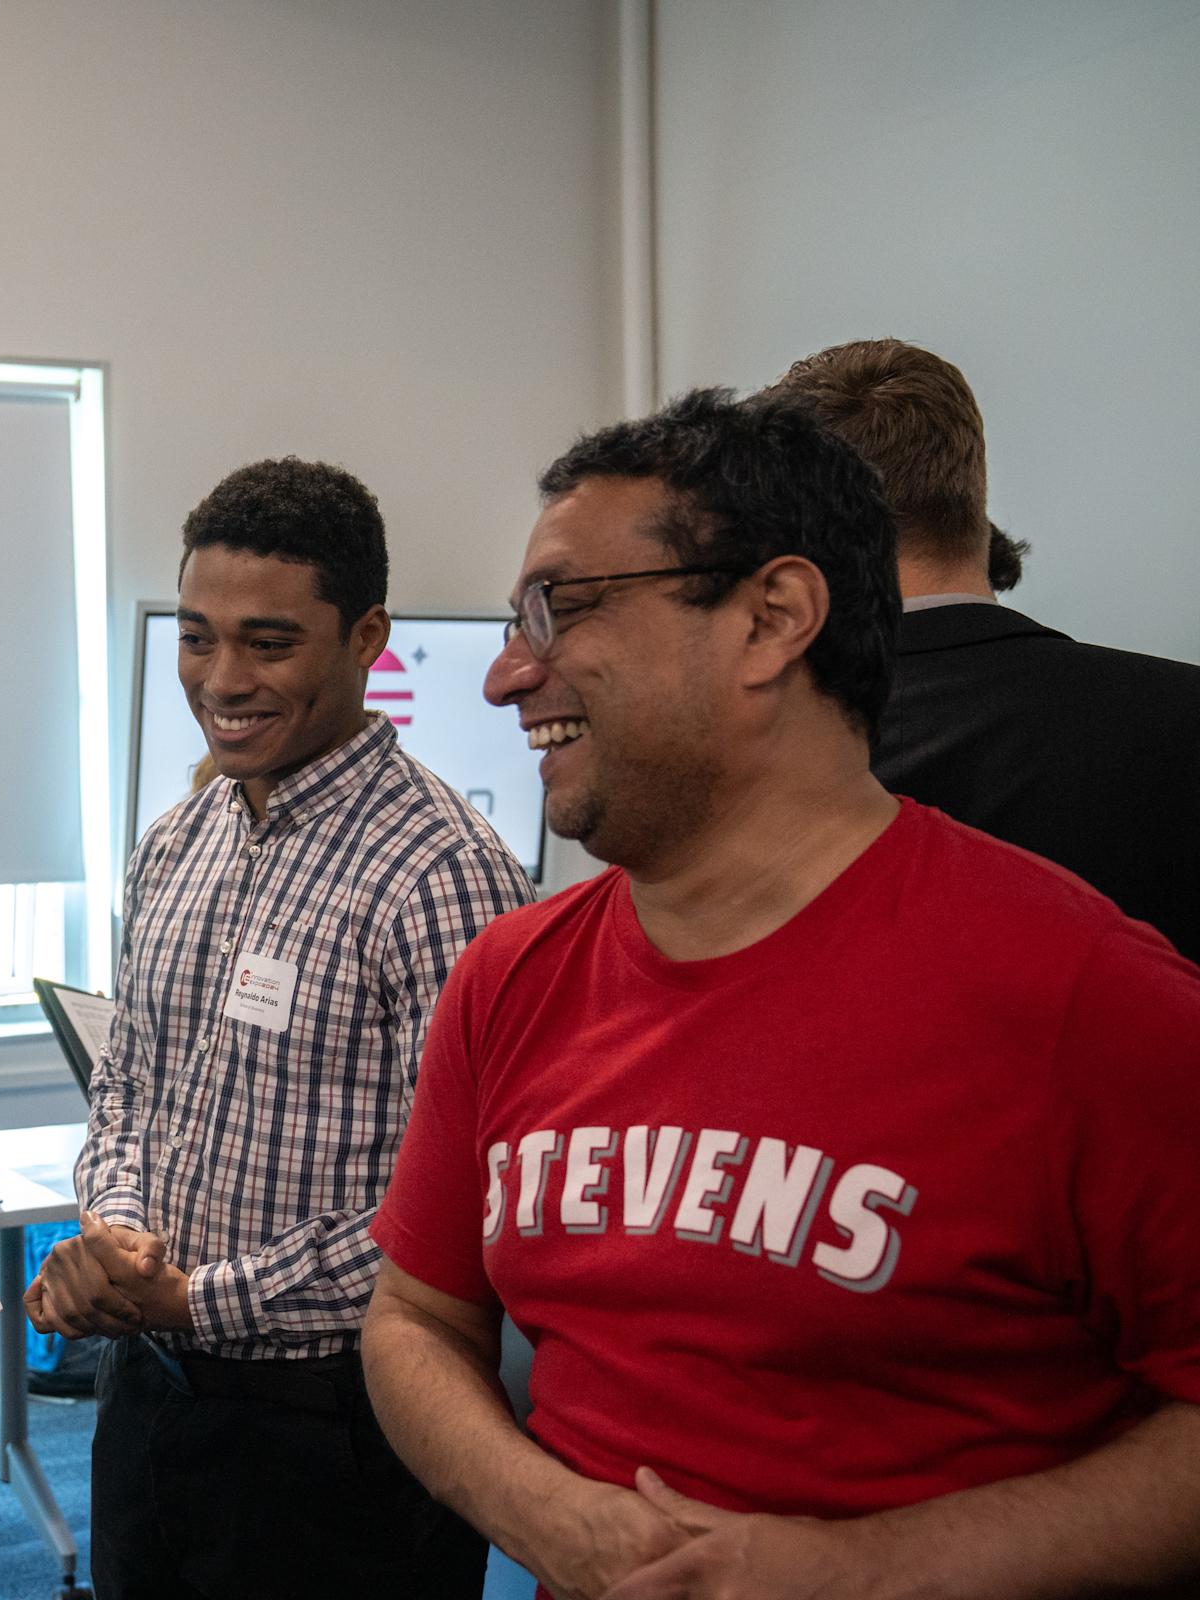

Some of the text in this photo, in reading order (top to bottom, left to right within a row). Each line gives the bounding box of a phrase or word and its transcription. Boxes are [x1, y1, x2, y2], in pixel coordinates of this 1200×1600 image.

[235, 988, 278, 1007] Reynaldo Arias
[482, 1125, 919, 1294] STEVENS
